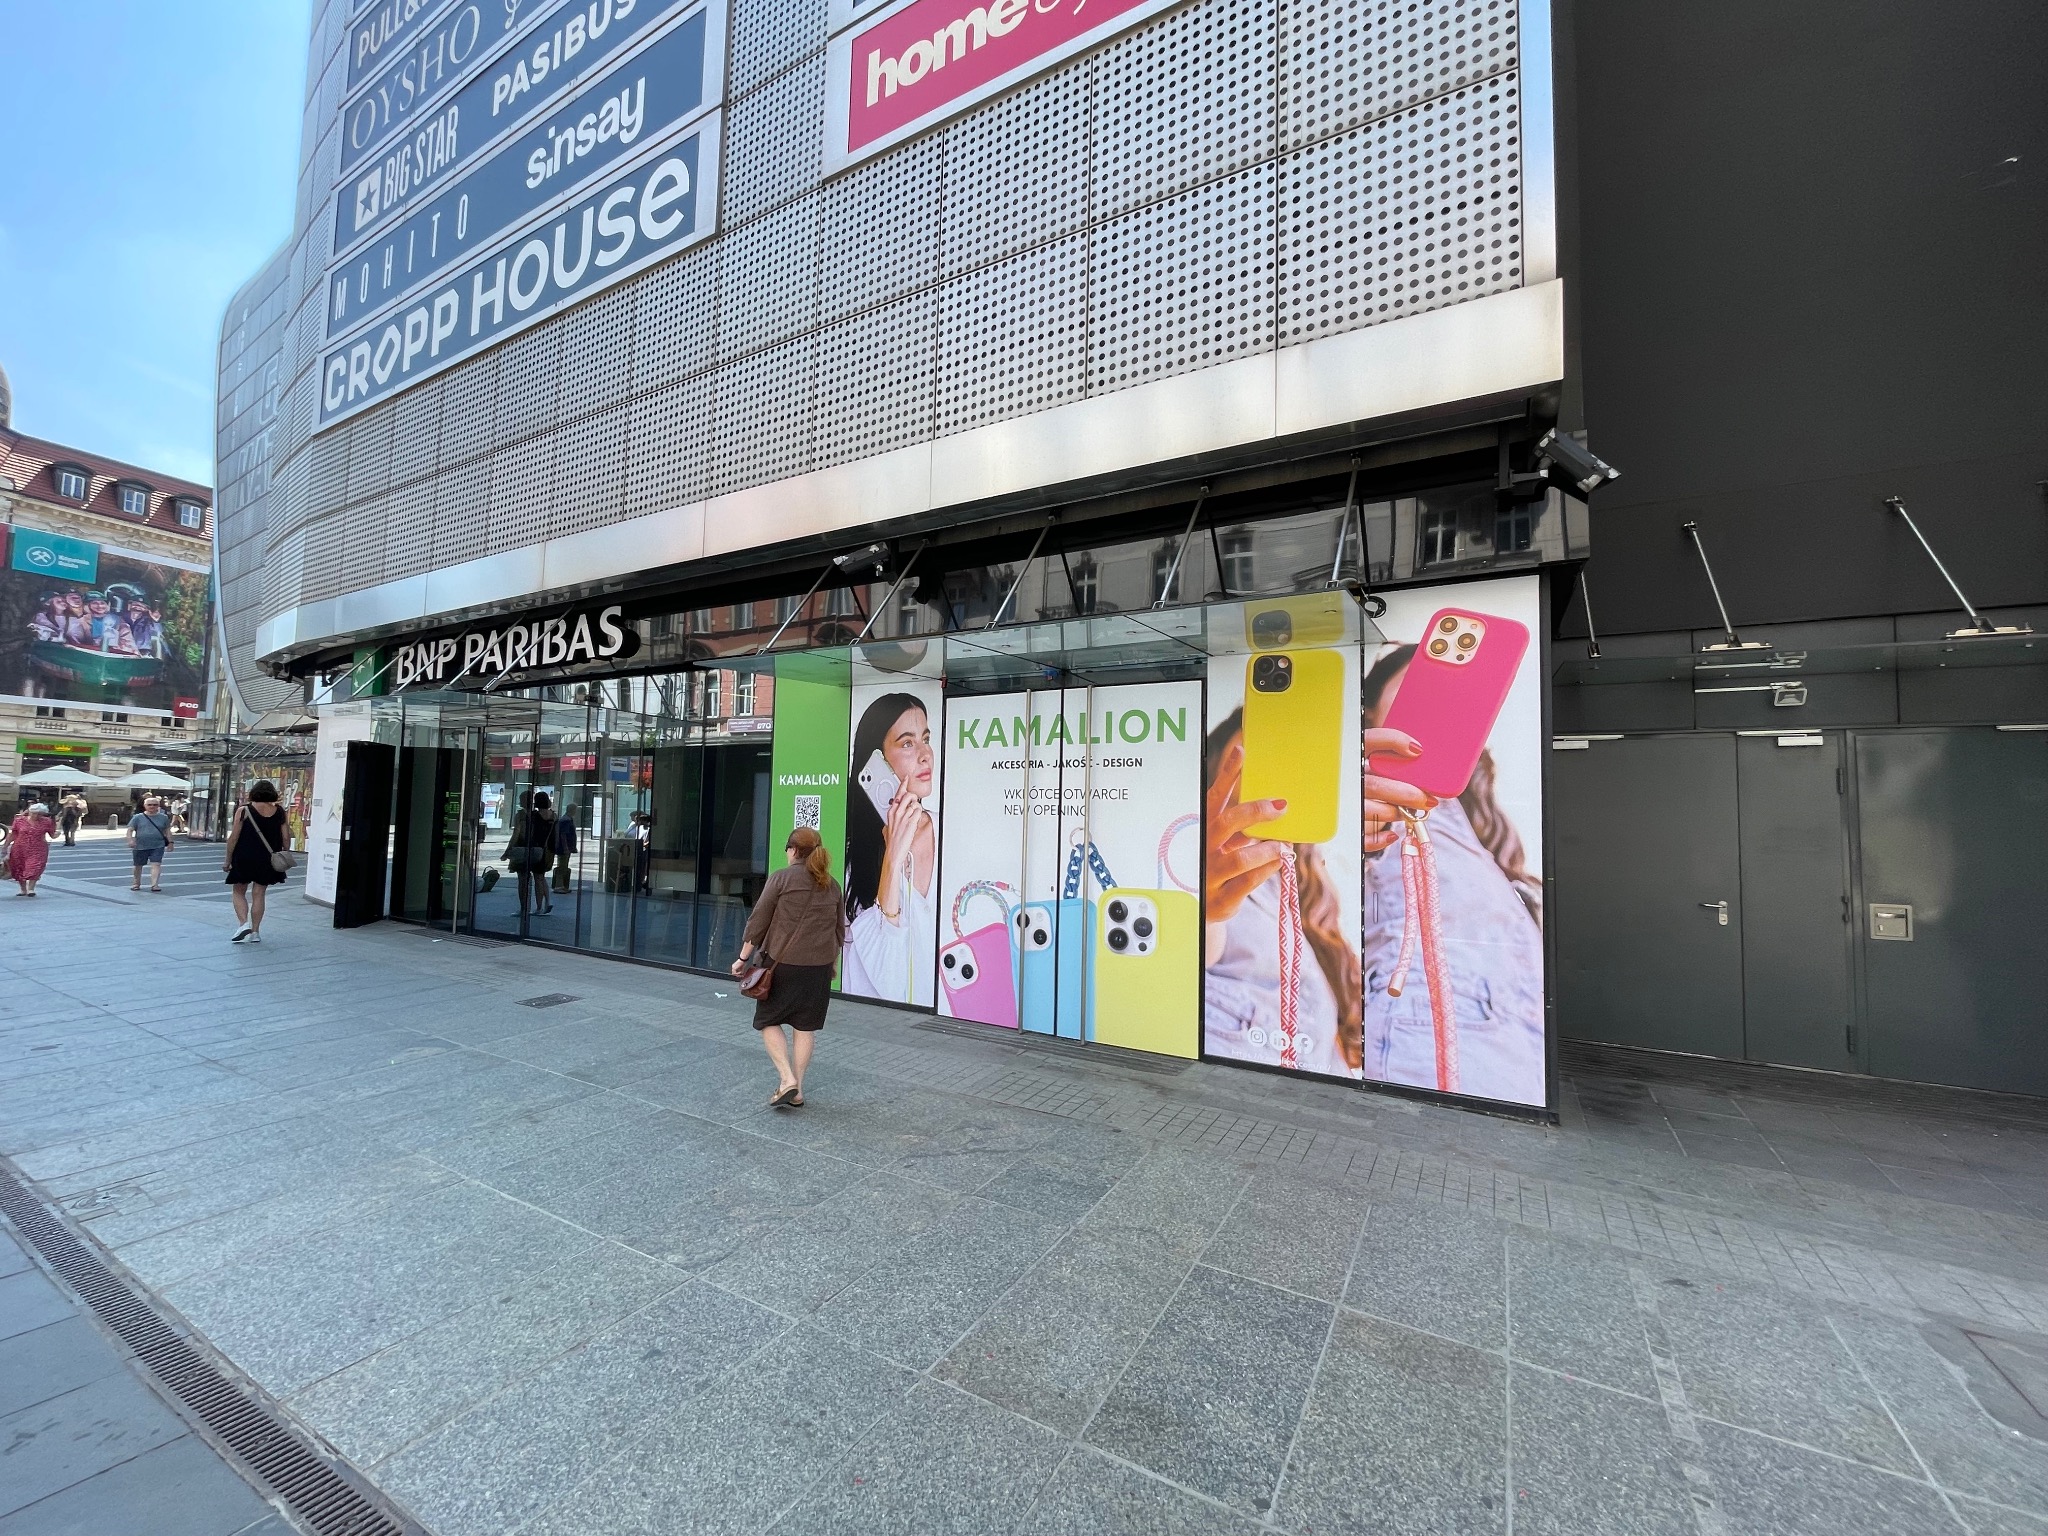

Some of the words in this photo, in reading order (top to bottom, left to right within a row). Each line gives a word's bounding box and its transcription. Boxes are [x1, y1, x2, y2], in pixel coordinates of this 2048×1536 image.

[358, 0, 430, 69] PULL&
[866, 0, 1028, 107] home
[352, 5, 480, 149] OYSHO
[382, 144, 411, 211] BIG
[413, 105, 459, 186] STAR
[526, 77, 646, 189] sinsay
[325, 288, 459, 412] CROPP
[396, 638, 457, 685] BNP
[464, 605, 624, 676] PARIBAS
[958, 707, 1187, 750] KAMALION
[1103, 757, 1143, 768] DESIGN
[779, 773, 840, 786] KAMALION
[1003, 785, 1060, 800] WKÓTCE
